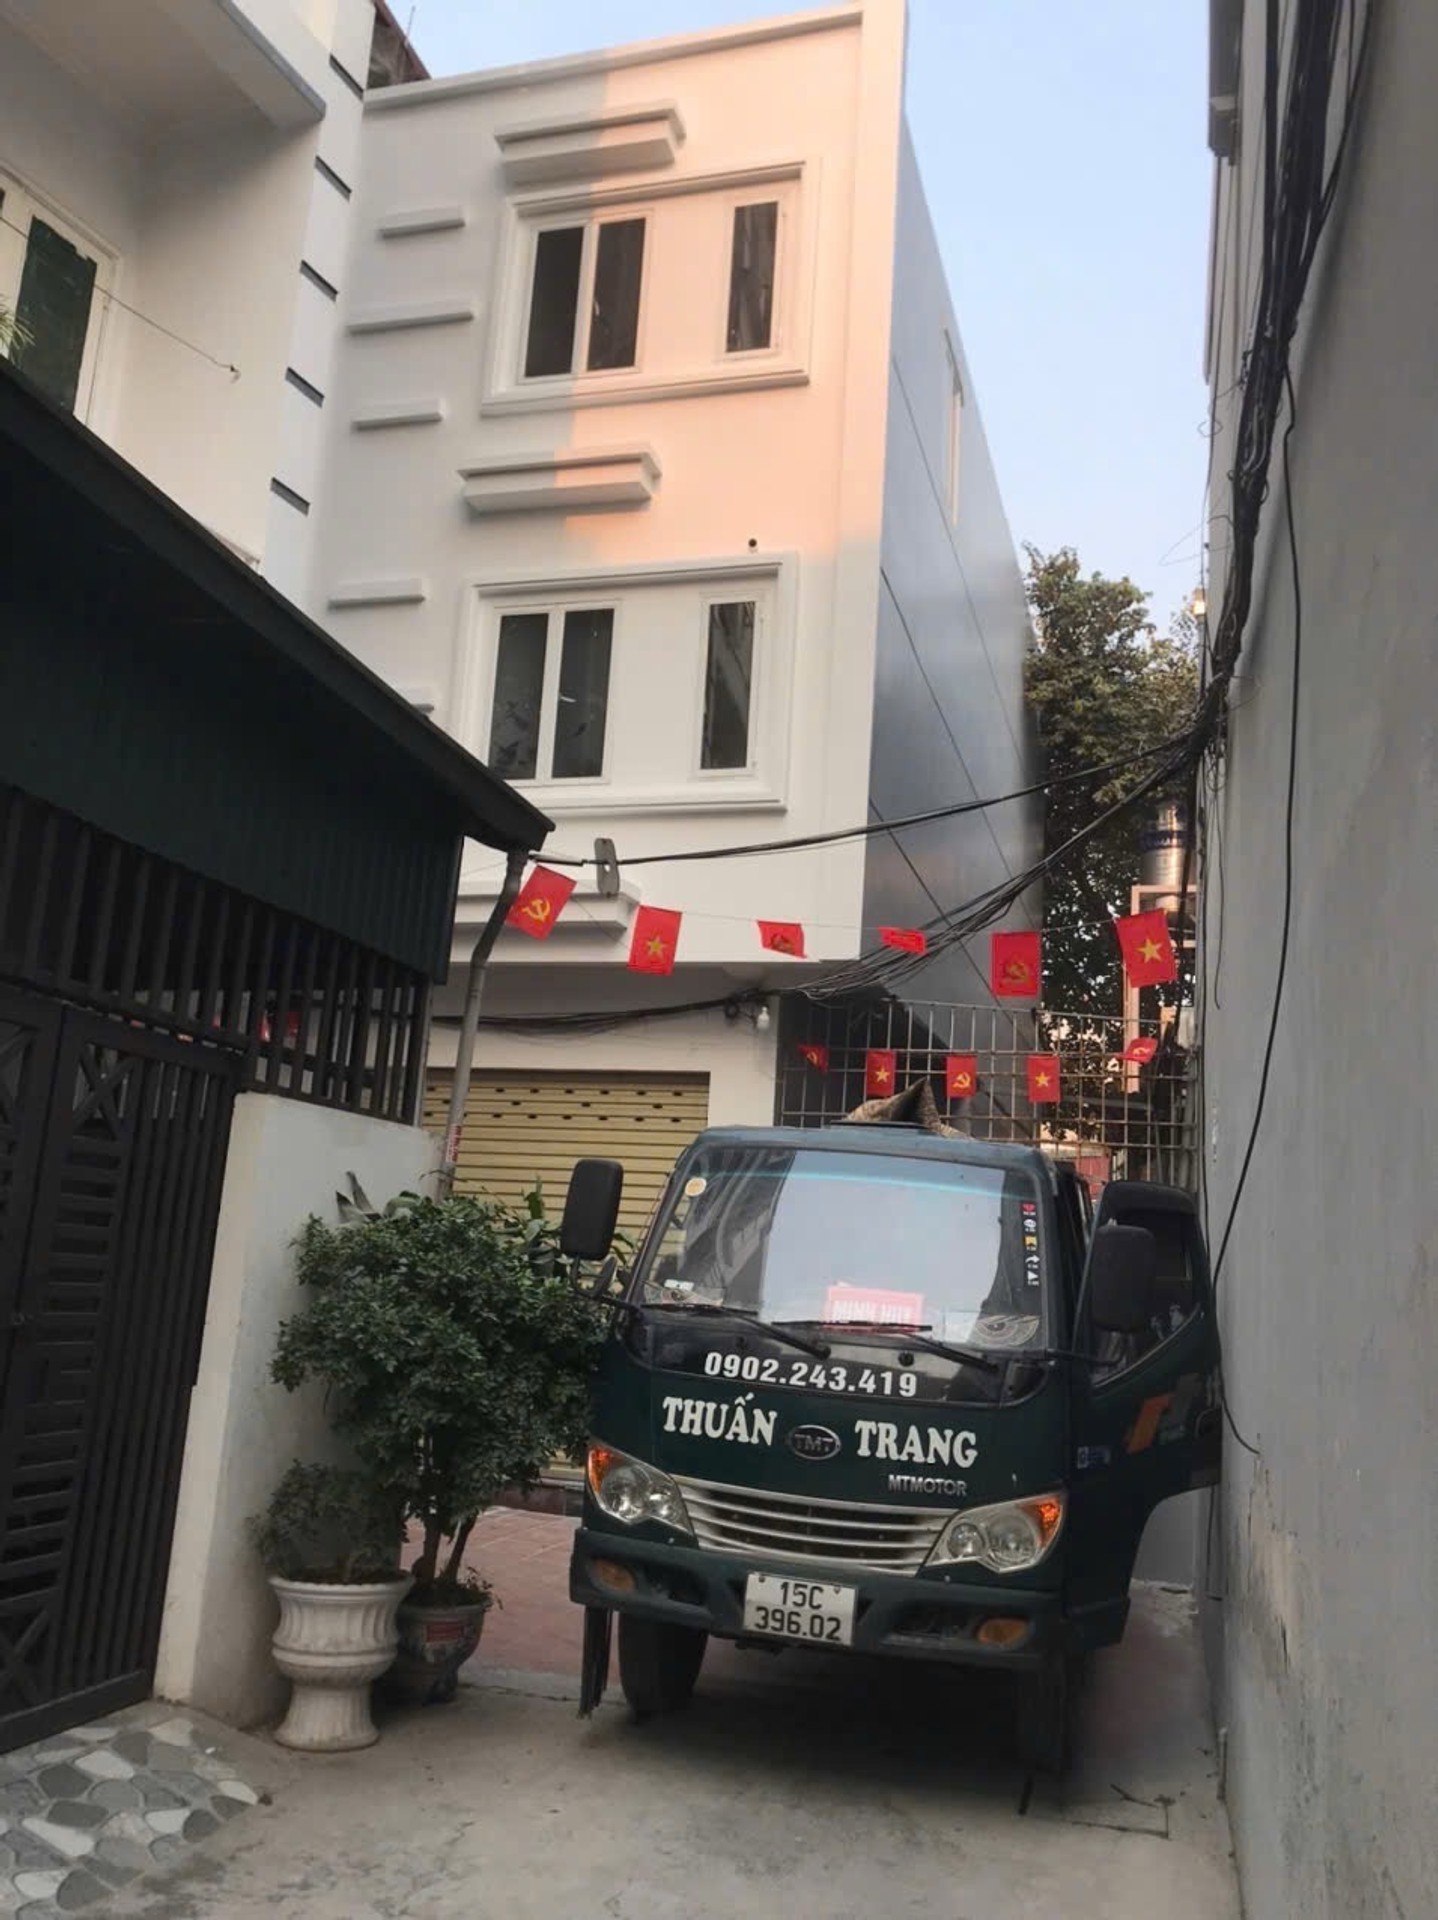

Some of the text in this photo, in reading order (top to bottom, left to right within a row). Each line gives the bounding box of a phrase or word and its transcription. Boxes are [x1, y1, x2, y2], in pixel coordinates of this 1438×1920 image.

[704, 1351, 918, 1397] 0902.243.419
[662, 1392, 979, 1468] THUẤN TRANG
[888, 1474, 967, 1497] MTMOTOR
[780, 1581, 824, 1610] 15C
[754, 1606, 842, 1641] 396.02
